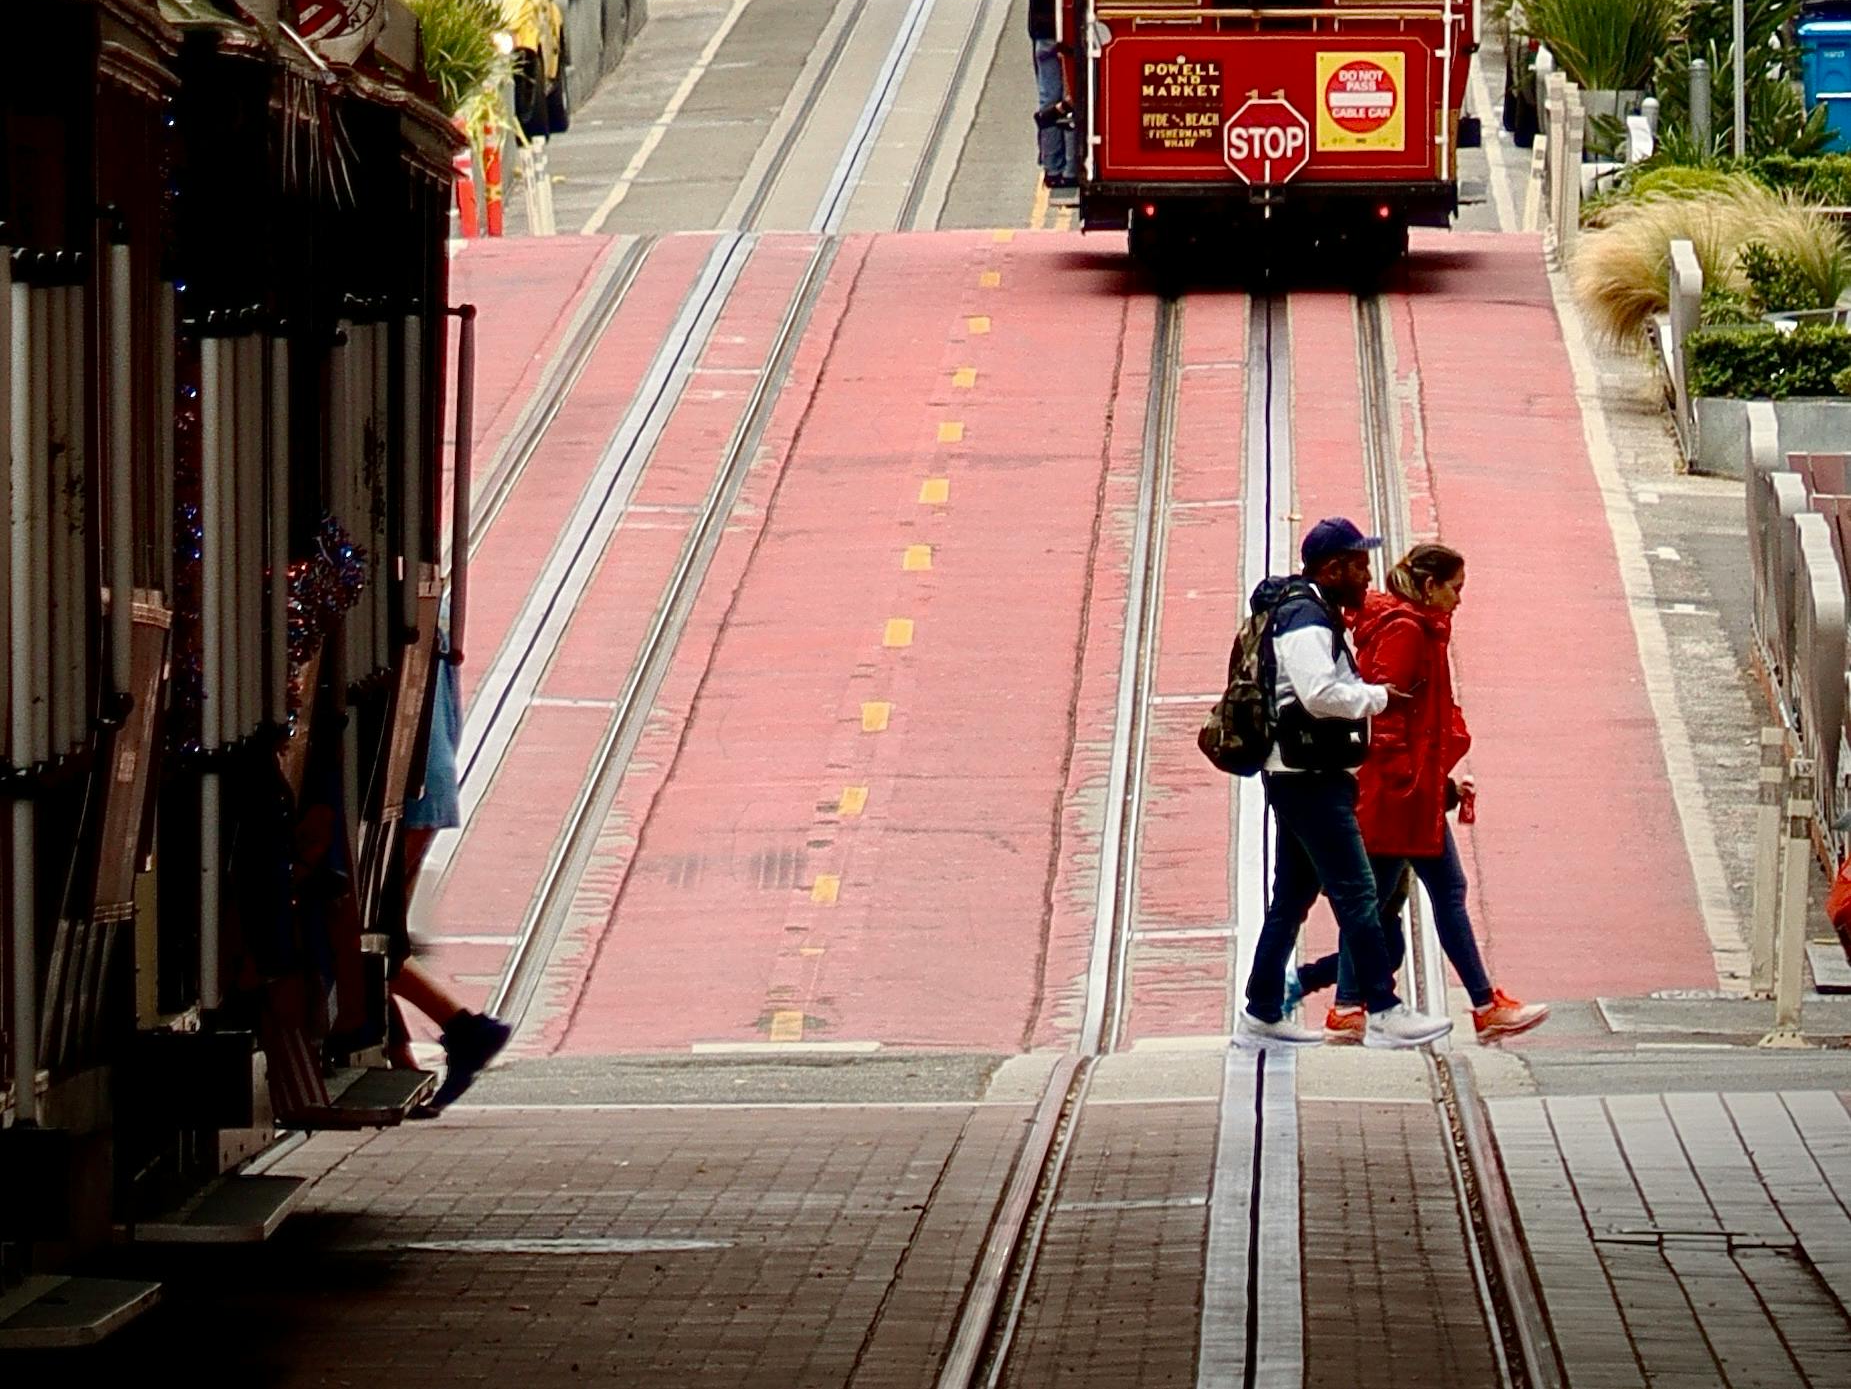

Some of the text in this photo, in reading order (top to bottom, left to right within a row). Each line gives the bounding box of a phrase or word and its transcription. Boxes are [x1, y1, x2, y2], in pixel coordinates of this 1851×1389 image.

[1143, 62, 1220, 76] POWELL
[1164, 75, 1201, 85] AND
[1338, 70, 1384, 82] DO NOT
[1142, 84, 1221, 97] MARKET
[1346, 81, 1377, 92] PASS
[1331, 107, 1391, 119] CABLE CAR
[1142, 113, 1170, 128] HYDE
[1185, 112, 1220, 127] BEACH
[1148, 128, 1213, 140] FISHERMANS
[1164, 138, 1198, 149] WHARF
[1229, 125, 1304, 160] STOP
